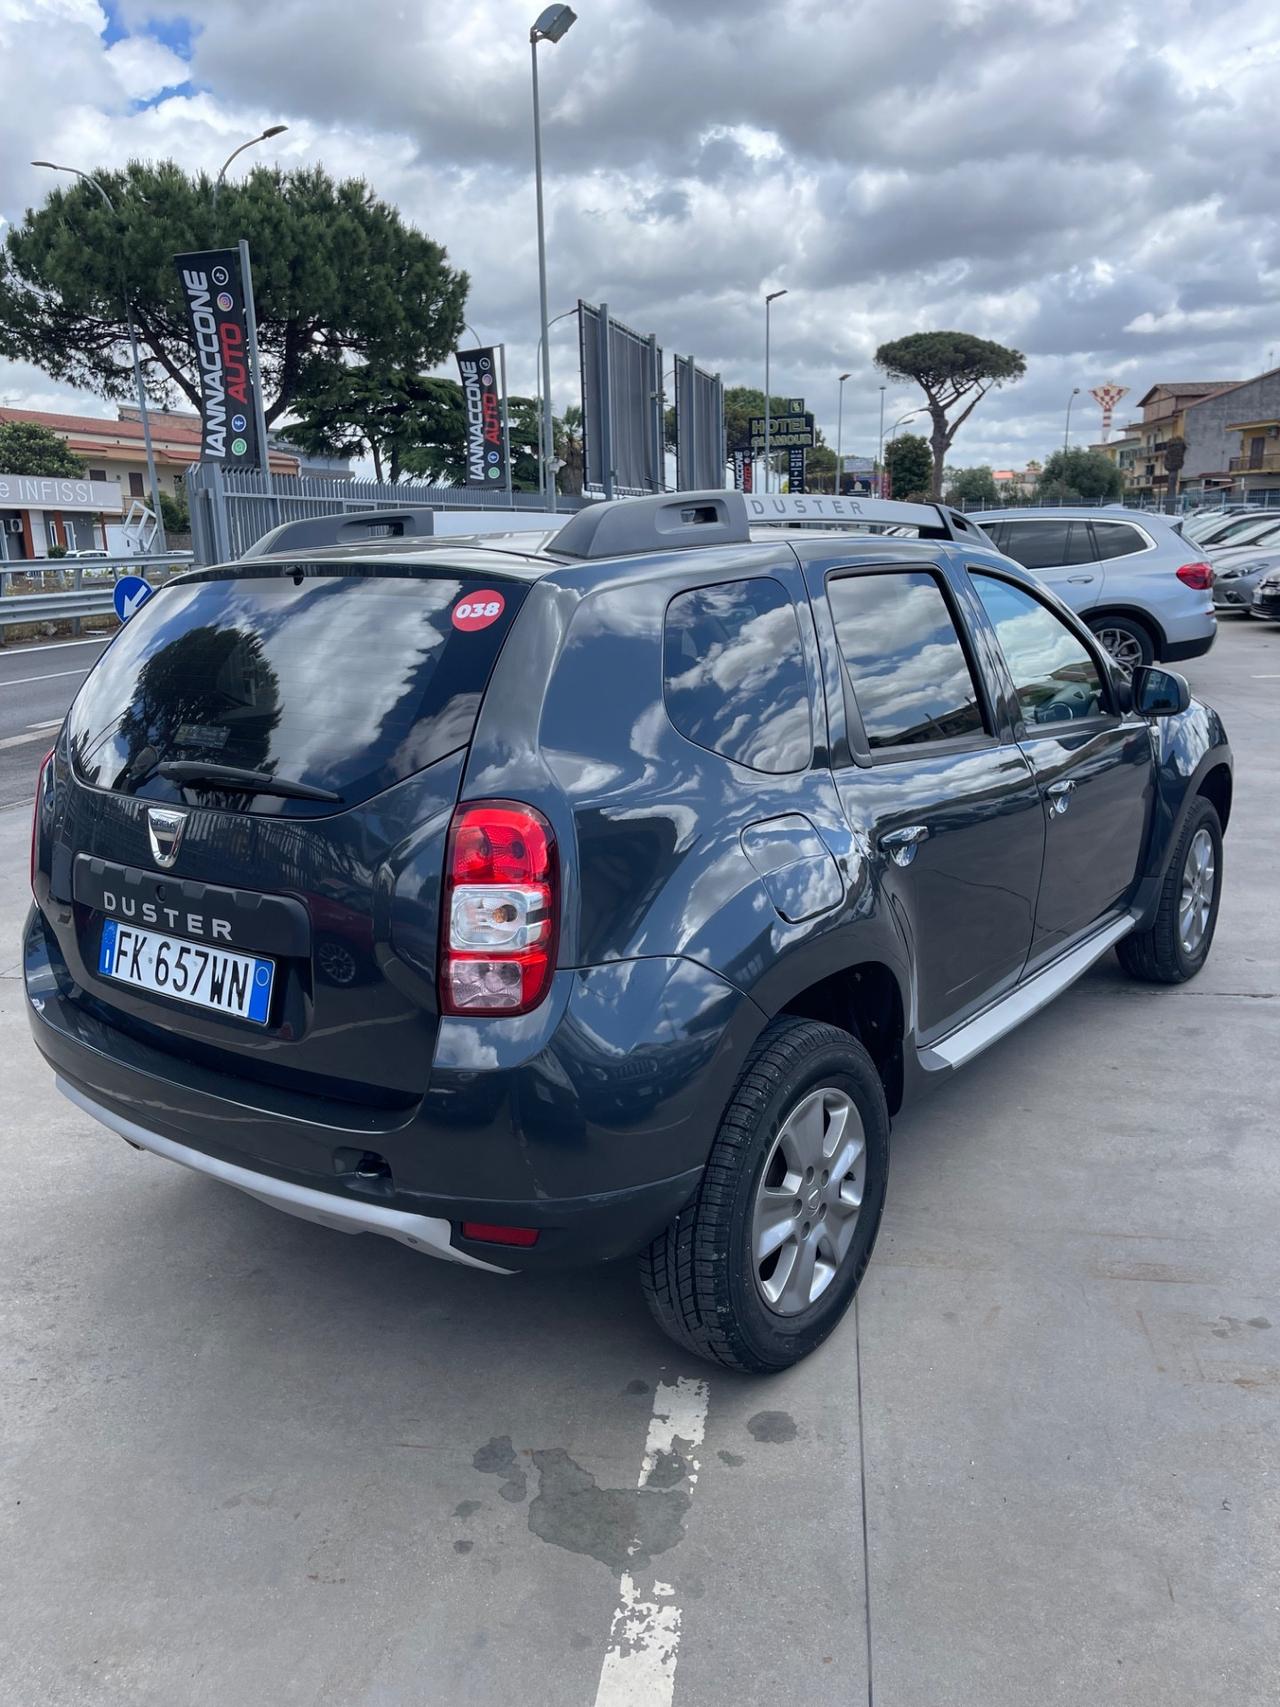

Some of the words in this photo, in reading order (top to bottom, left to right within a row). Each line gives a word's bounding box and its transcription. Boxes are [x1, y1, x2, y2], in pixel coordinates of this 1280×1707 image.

[183, 269, 226, 457] IANNACCONE
[219, 322, 248, 405] AUTO
[460, 360, 485, 480] IANNACCONE
[482, 392, 501, 445] AUTO
[751, 417, 811, 434] HOTEL
[751, 433, 812, 447] GLAMOUR
[18, 479, 94, 503] INFISSI
[750, 499, 864, 515] DUSTER
[456, 602, 500, 619] 038
[103, 891, 233, 941] DUSTER
[115, 930, 148, 981] FK
[154, 941, 250, 1011] 657WN
